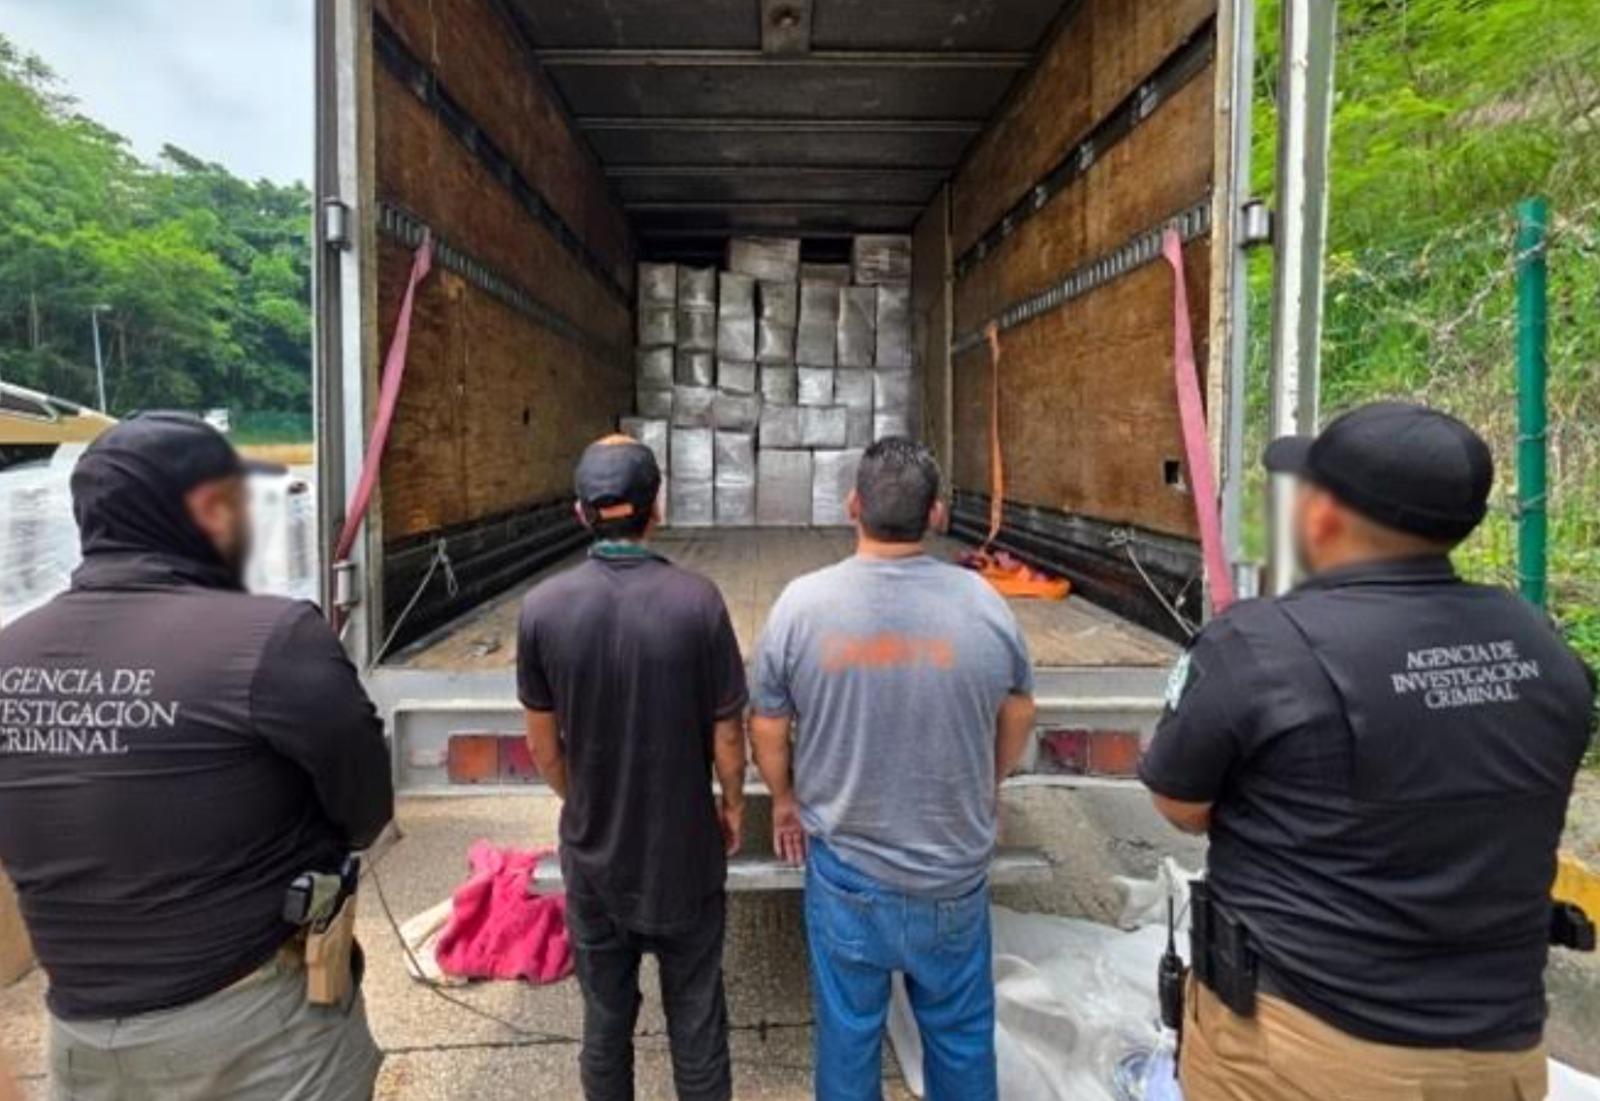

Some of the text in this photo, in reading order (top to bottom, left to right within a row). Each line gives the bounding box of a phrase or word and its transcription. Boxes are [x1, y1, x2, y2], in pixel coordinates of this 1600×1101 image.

[1408, 640, 1518, 668] AGENCIA DE
[0, 667, 156, 695] GENCIA DE
[0, 699, 179, 728] ESTIGACIÓN
